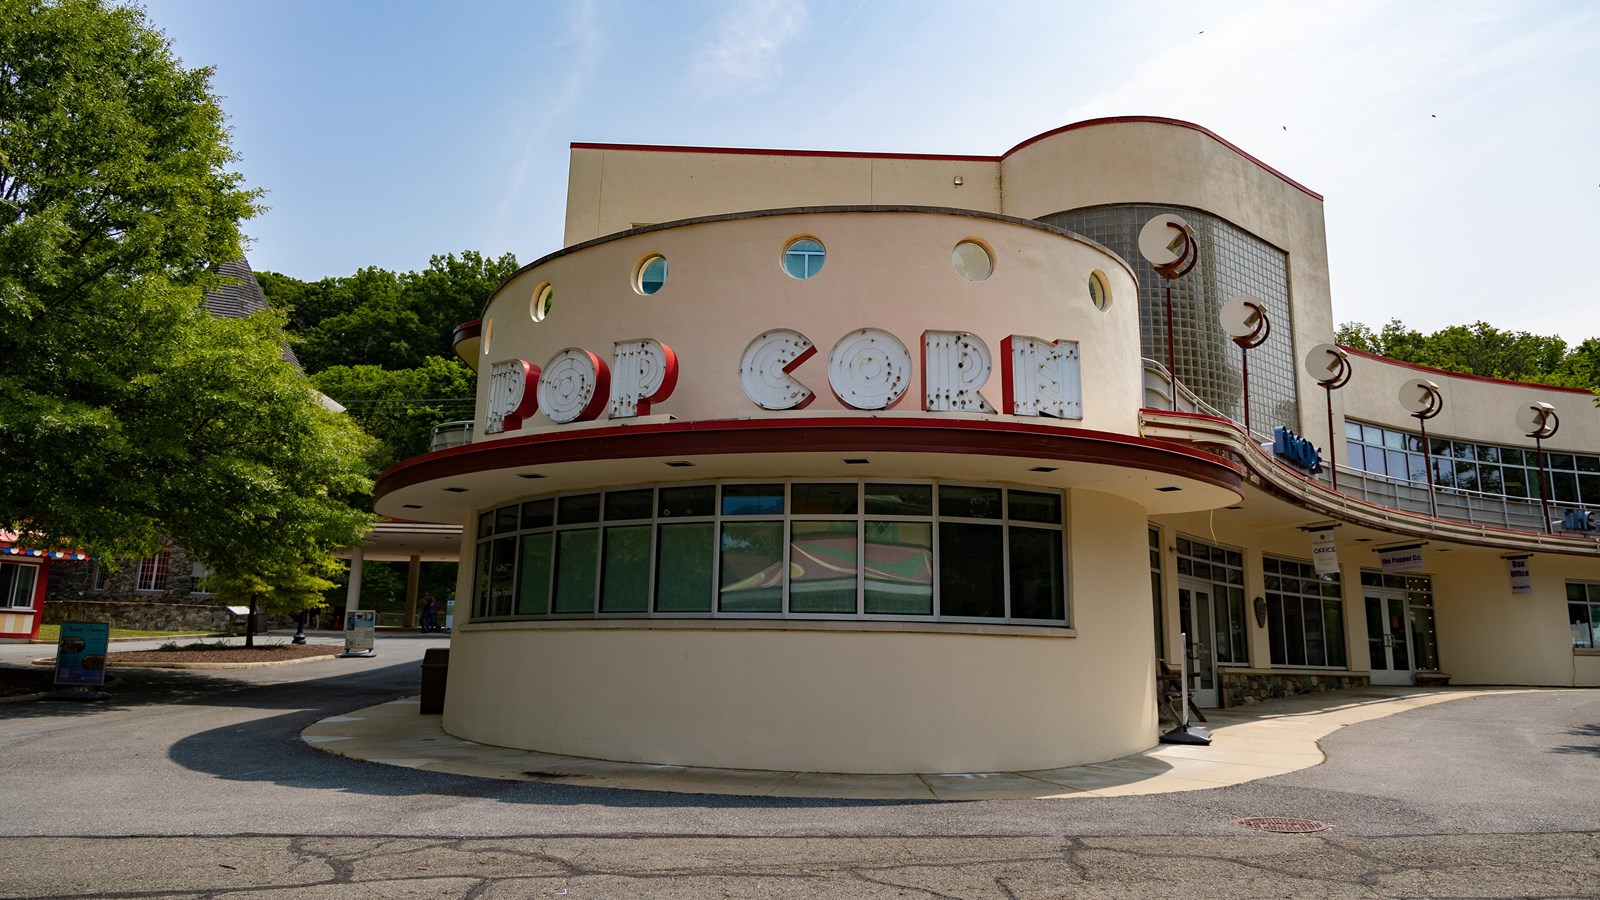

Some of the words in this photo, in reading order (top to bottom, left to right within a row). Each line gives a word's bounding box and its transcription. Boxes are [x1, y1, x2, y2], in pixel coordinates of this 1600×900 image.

[485, 338, 679, 435] POP
[739, 327, 1083, 420] CORN
[1512, 560, 1525, 568] Box
